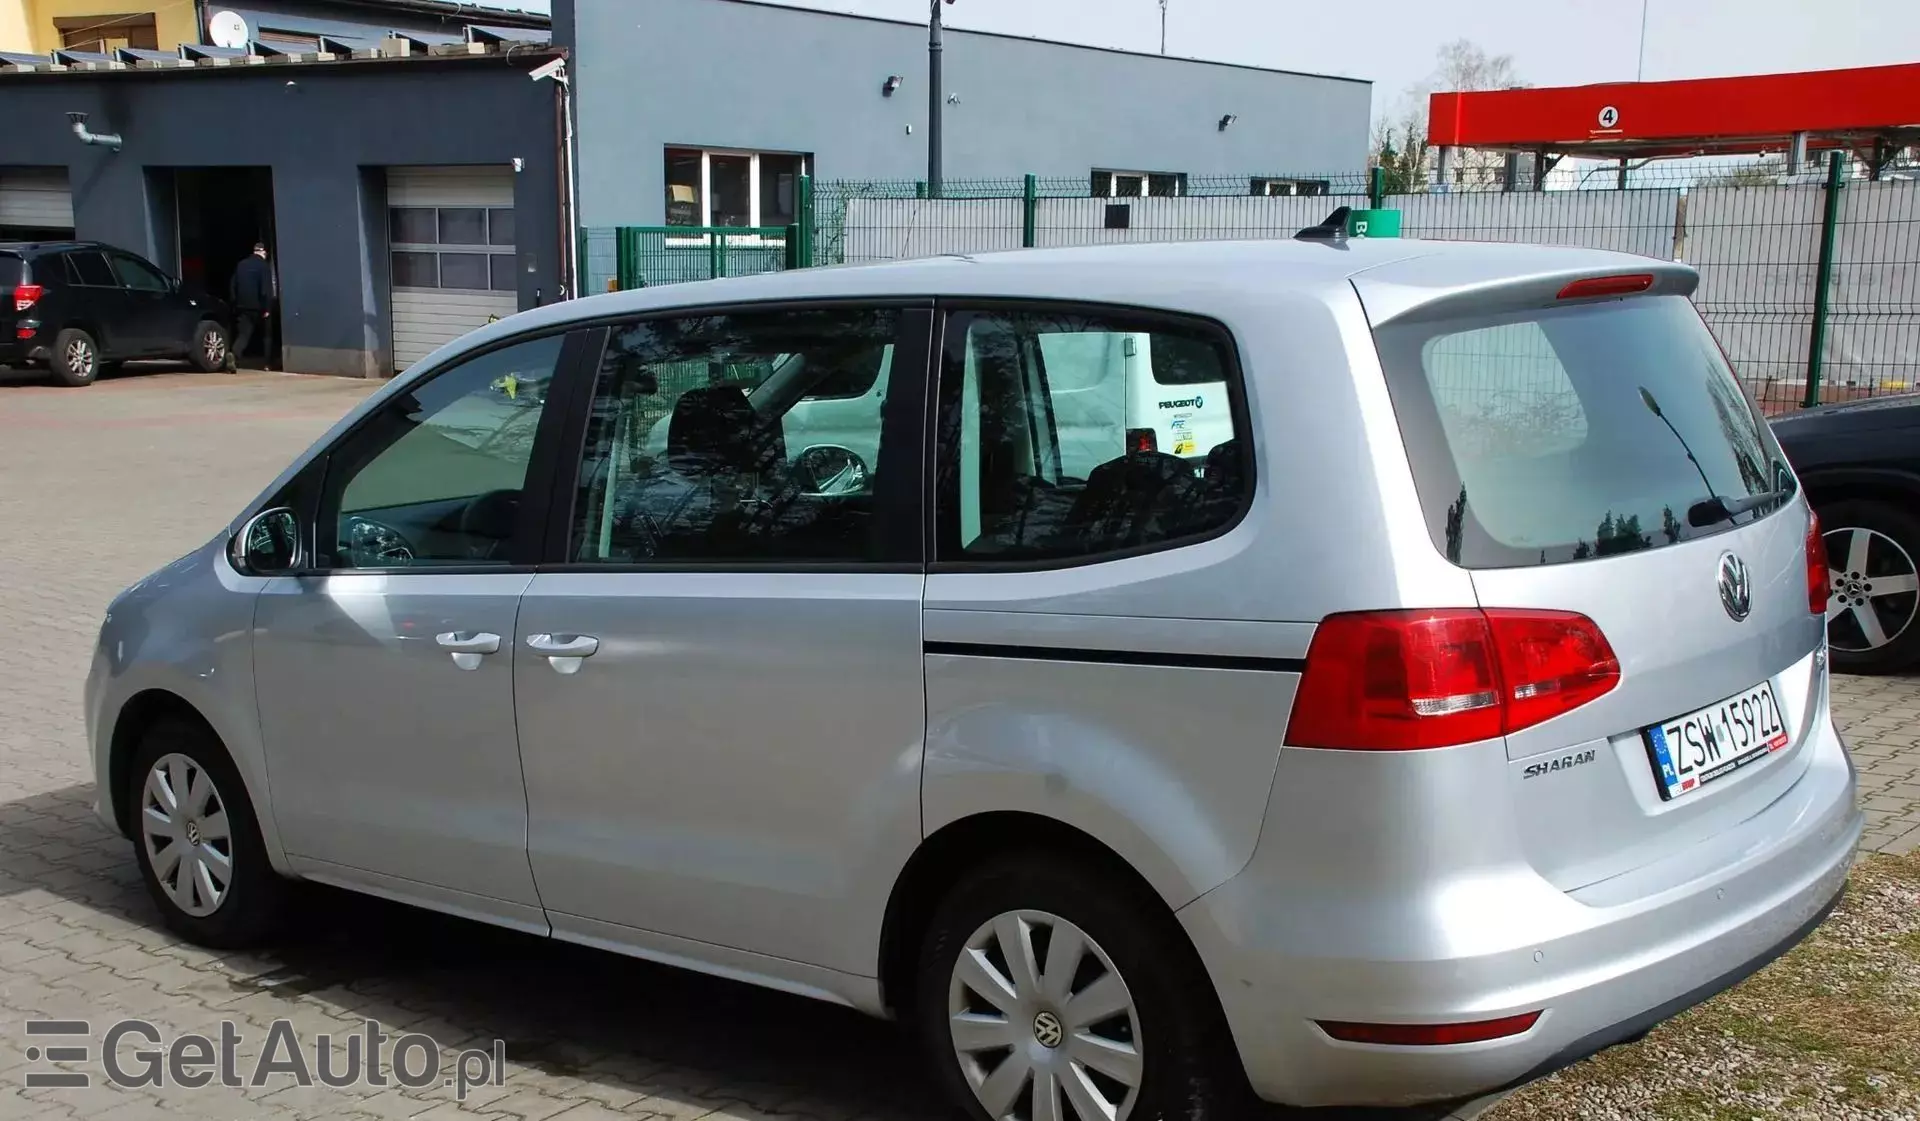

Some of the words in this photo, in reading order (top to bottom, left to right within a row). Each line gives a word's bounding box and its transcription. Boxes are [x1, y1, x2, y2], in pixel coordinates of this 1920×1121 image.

[1602, 109, 1614, 124] 4
[1159, 399, 1196, 409] PEUGEOT
[1666, 713, 1721, 776] ZSW
[1721, 689, 1779, 751] 15922
[1523, 749, 1596, 780] SHARAN
[1662, 763, 1675, 778] PL
